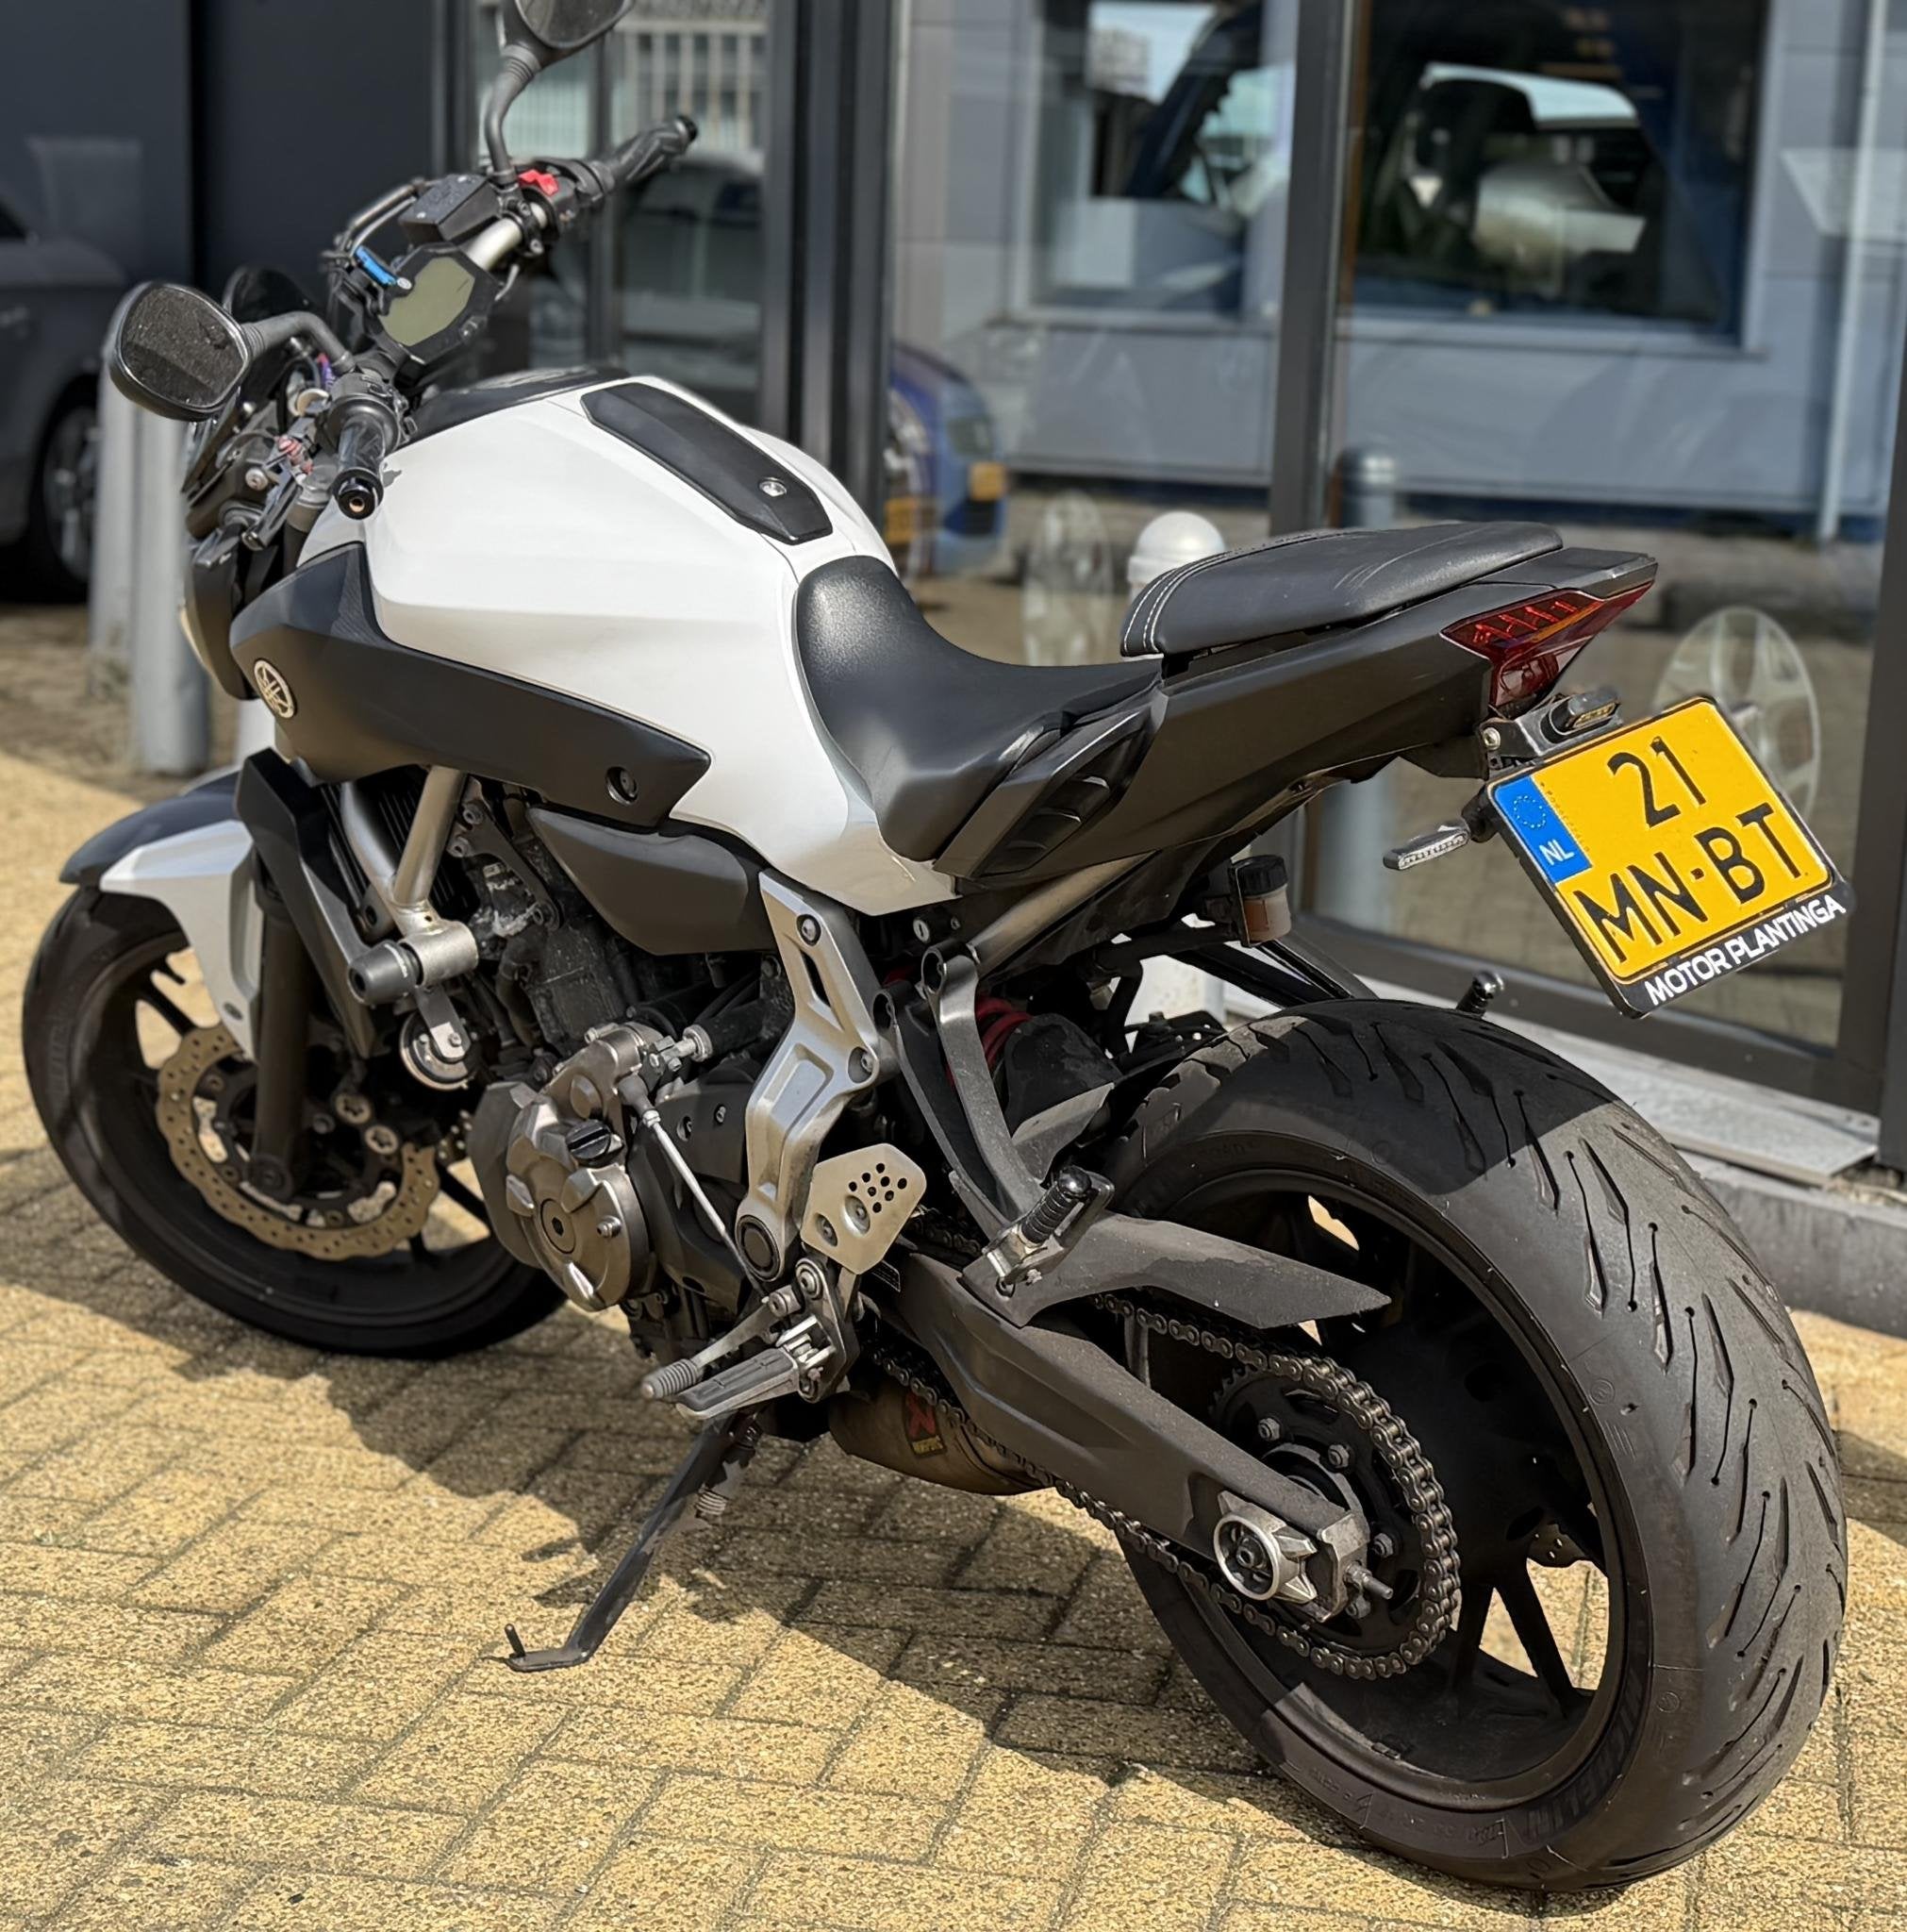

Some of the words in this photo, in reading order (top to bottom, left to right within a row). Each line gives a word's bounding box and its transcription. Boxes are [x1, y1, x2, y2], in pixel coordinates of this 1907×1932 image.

[1606, 736, 1707, 828] 21
[1538, 838, 1575, 867] NL
[1644, 947, 1731, 1007] MOTOR
[1725, 894, 1846, 967] PLANTINGA
